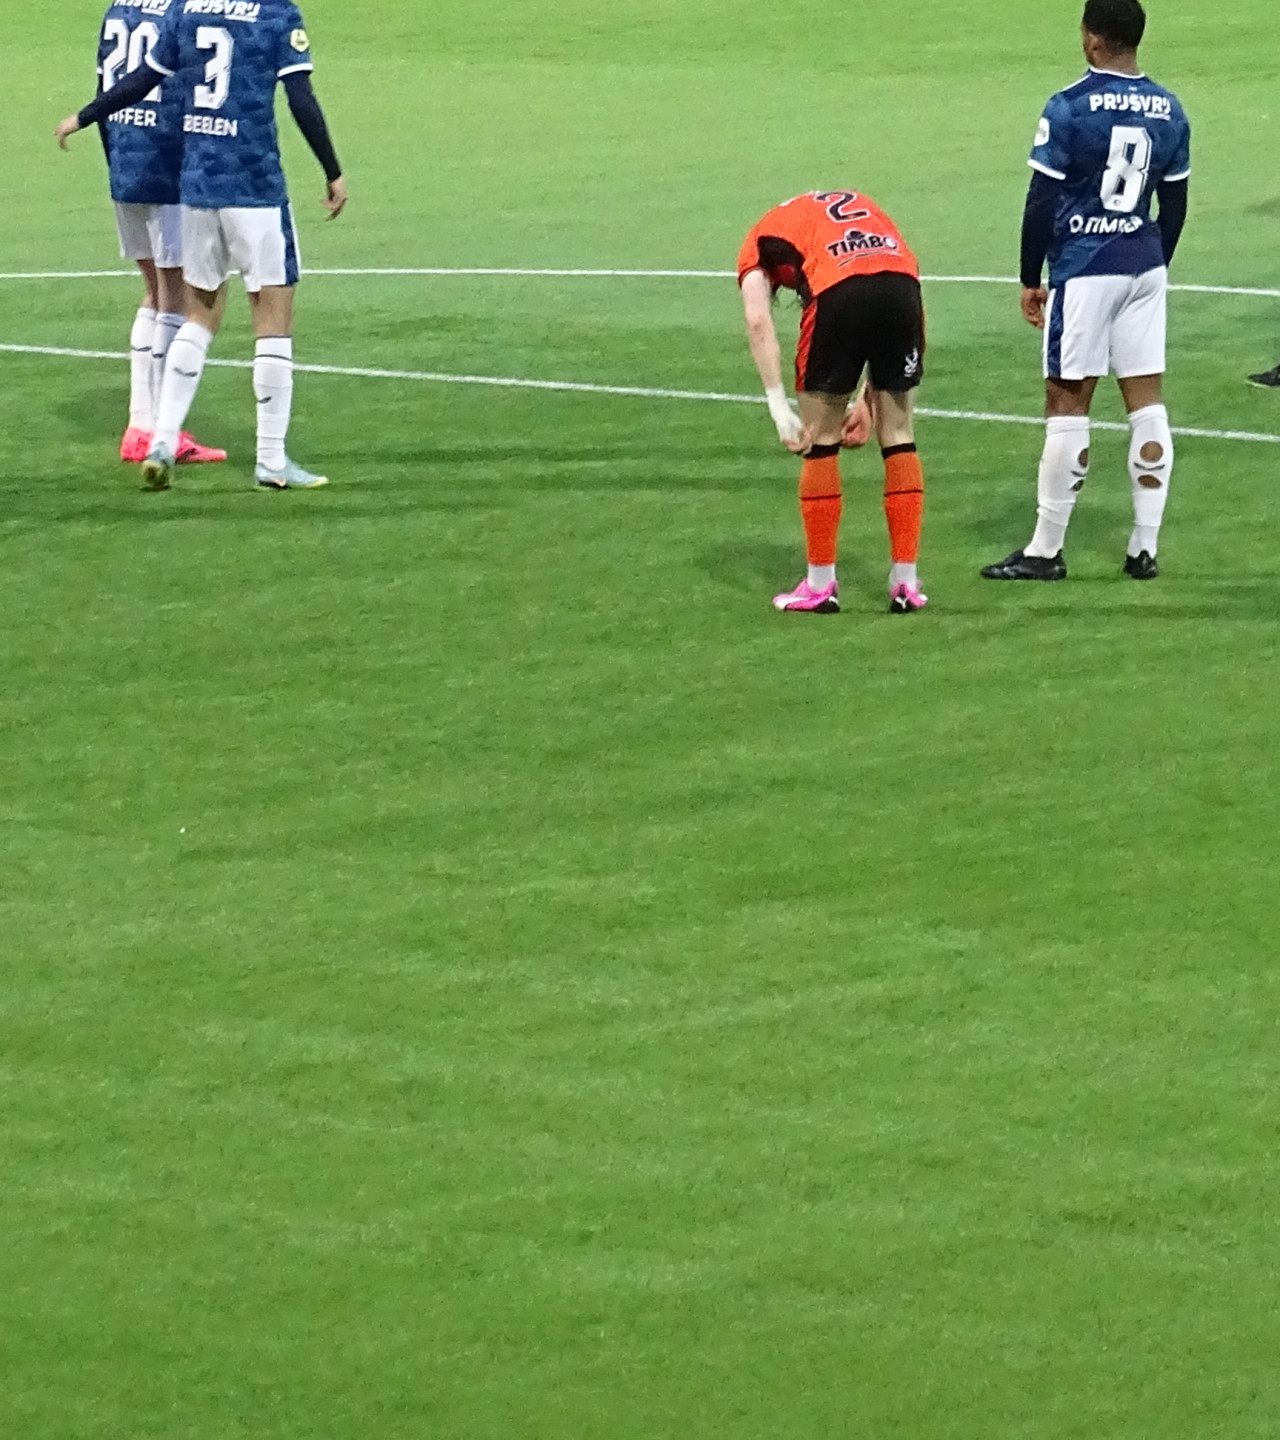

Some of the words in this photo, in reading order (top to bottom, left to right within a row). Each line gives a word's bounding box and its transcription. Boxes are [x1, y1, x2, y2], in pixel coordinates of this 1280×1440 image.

[194, 26, 234, 110] 3
[1100, 125, 1152, 213] 8
[815, 191, 871, 223] 2
[828, 233, 898, 258] TIMBO
